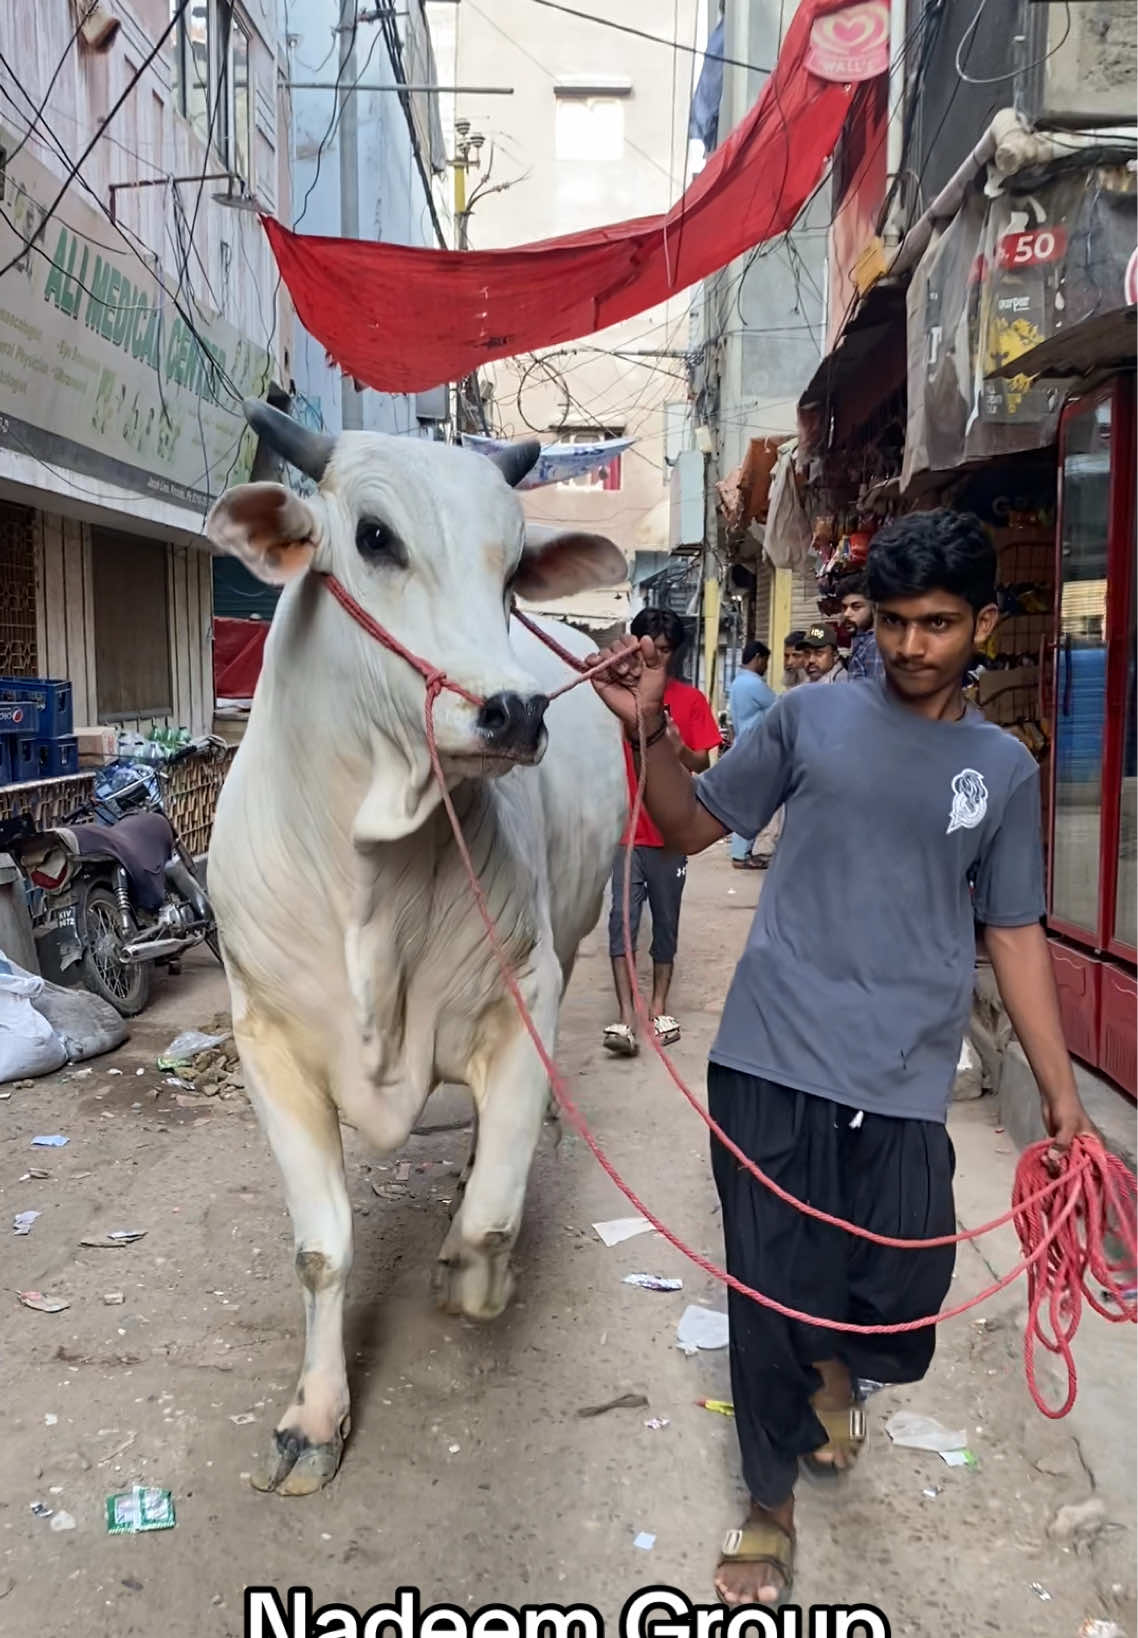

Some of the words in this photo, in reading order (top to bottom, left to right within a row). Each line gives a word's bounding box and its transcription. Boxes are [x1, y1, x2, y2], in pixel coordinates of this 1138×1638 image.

[1013, 232, 1055, 263] 50
[44, 226, 88, 320] ALI
[85, 253, 165, 371] MEDICAL
